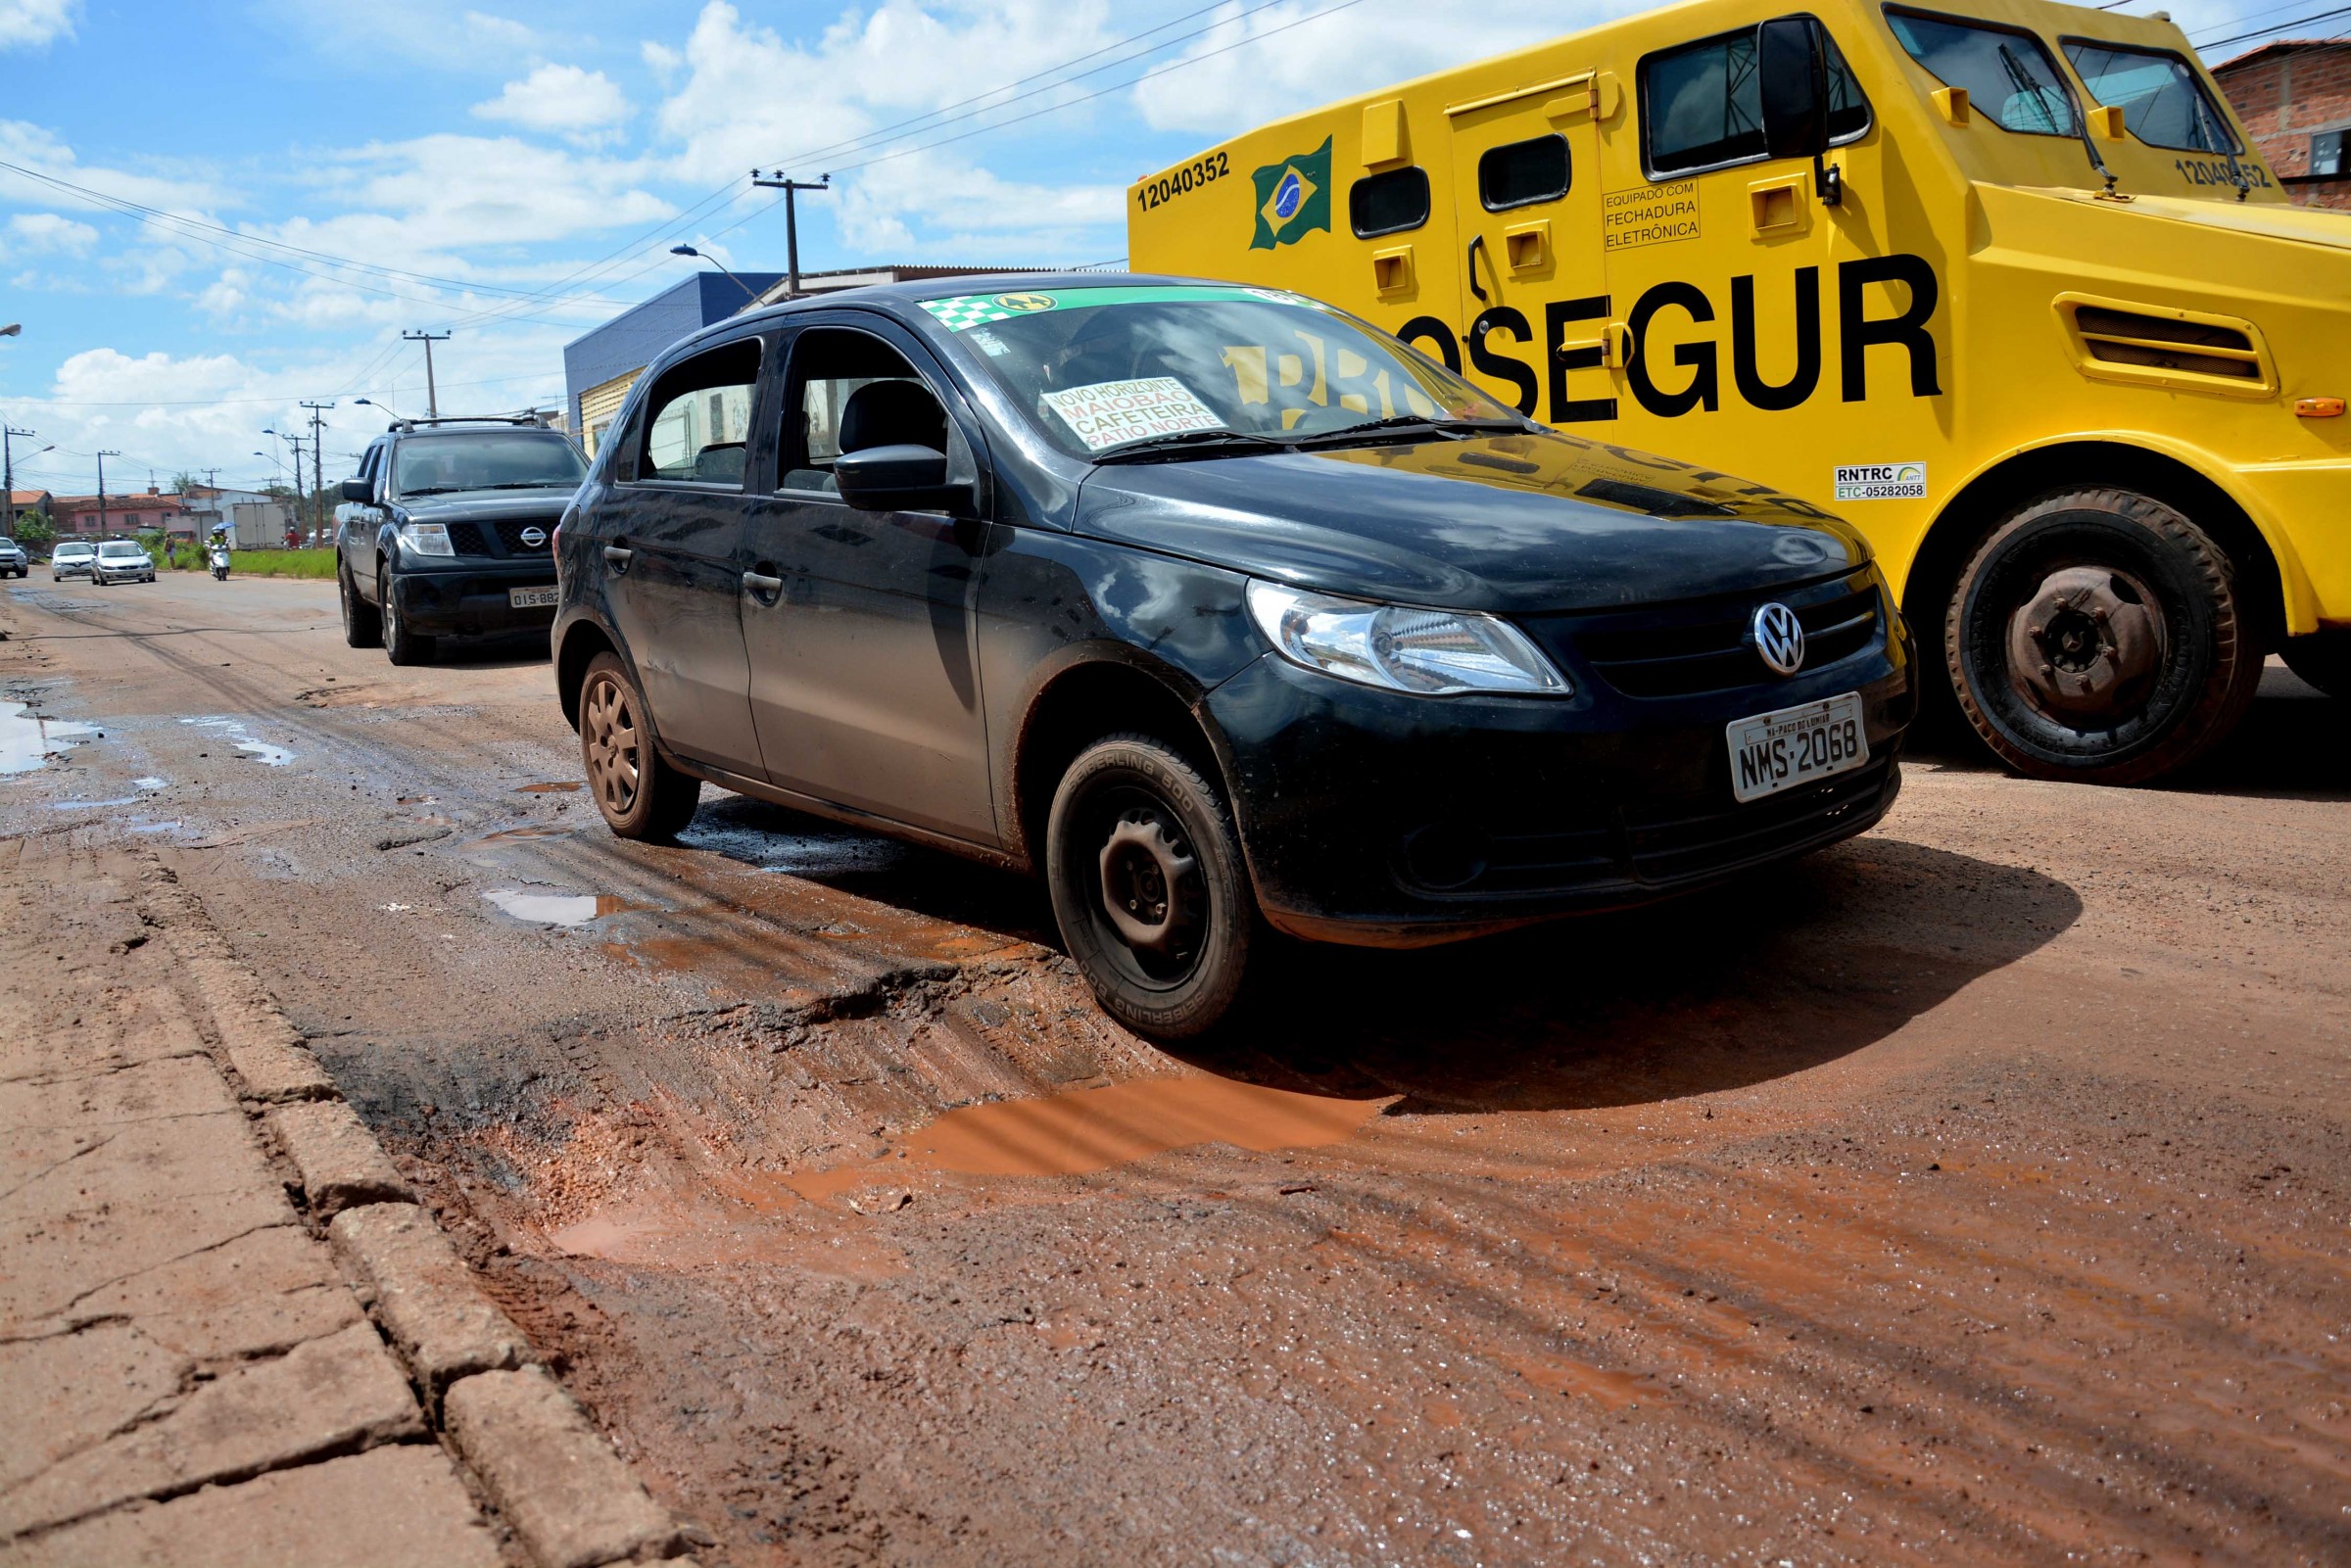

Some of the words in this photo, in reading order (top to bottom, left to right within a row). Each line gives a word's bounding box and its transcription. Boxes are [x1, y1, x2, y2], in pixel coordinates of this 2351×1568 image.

[1137, 151, 1230, 212] 12040352
[1607, 187, 1664, 208] EQUIPADO
[1666, 182, 1694, 197] COM
[1607, 200, 1697, 227] FECHADURA
[1607, 221, 1699, 248] ELETRÔNICA
[1053, 388, 1096, 408] NOVO
[1094, 378, 1182, 400] HORIZONTE
[1076, 403, 1211, 435] CAFETEIRA
[1150, 414, 1222, 434] NORTE
[1838, 467, 1893, 482] RNTRC
[1838, 485, 1924, 498] ETC-05282058
[1068, 752, 1155, 792] SEIBERLING
